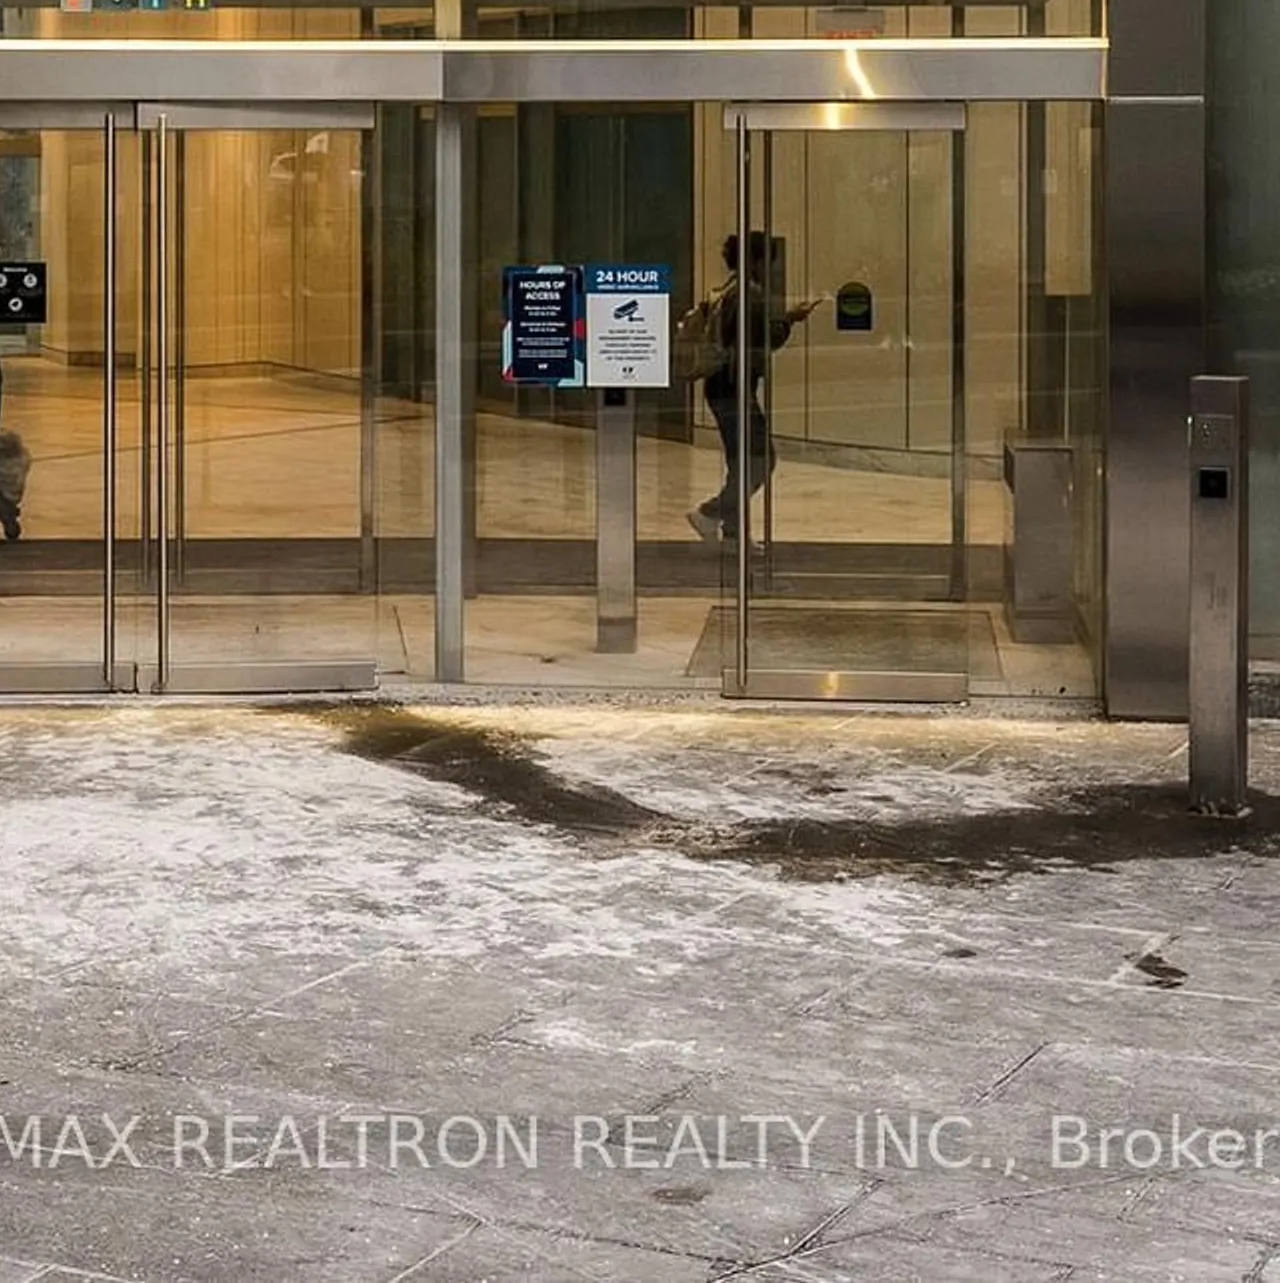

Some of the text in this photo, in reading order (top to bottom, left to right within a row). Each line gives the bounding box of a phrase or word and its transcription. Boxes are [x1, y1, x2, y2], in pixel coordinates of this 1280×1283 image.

[596, 270, 659, 283] 24 HOUR
[519, 280, 566, 290] HOURS OF
[525, 291, 561, 301] ACCESS
